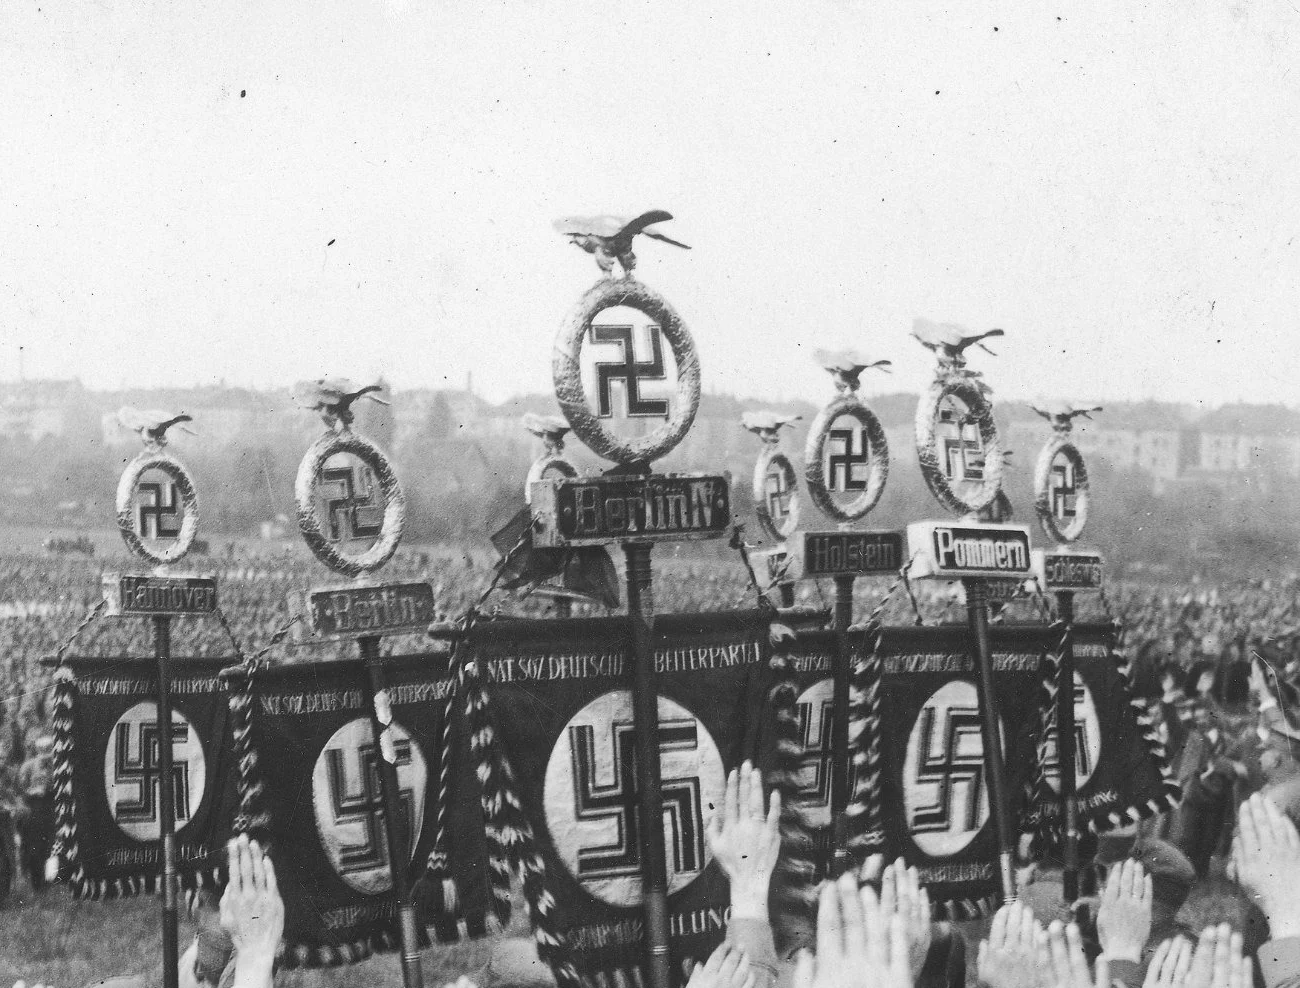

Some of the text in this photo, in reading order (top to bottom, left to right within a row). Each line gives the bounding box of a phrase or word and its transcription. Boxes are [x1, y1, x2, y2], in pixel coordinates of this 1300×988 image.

[575, 478, 688, 533] Berlin
[813, 536, 895, 571] Holstein
[936, 528, 1027, 569] Pommern
[119, 578, 214, 609] Hannover
[654, 642, 760, 674] BEITERPARTEI
